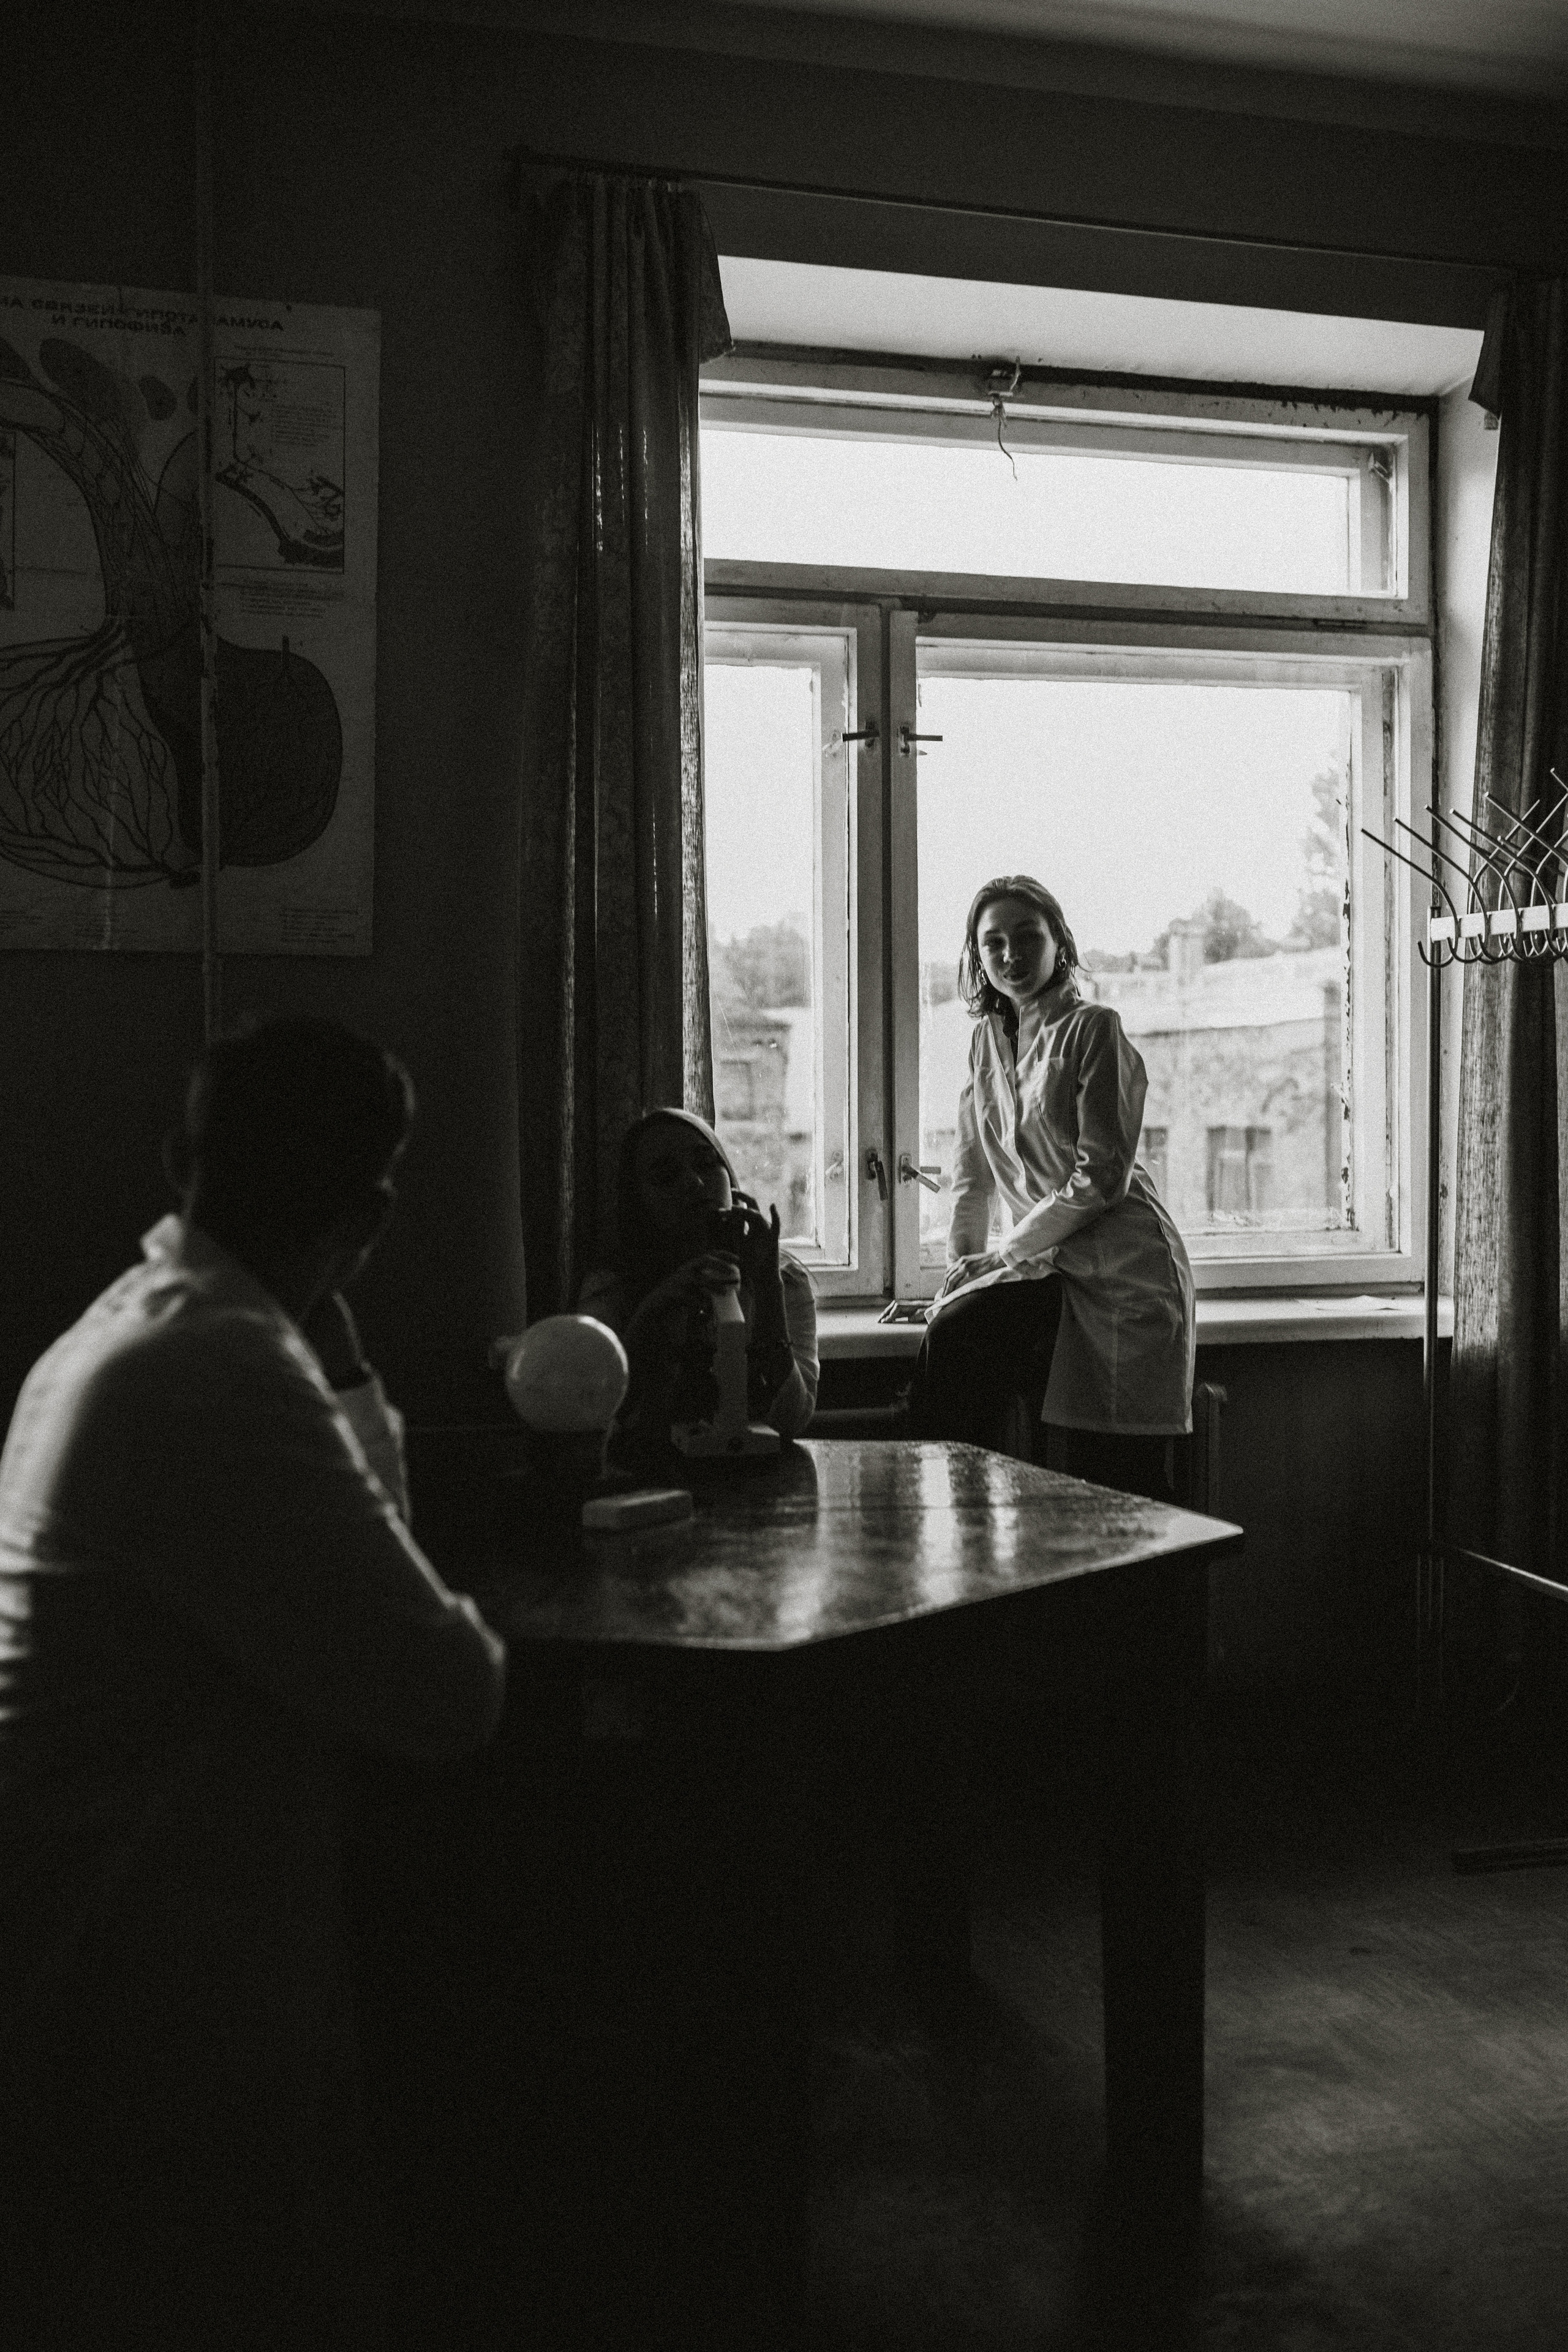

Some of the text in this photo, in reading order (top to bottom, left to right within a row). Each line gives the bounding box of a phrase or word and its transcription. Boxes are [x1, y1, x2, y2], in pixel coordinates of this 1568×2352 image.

[52, 314, 186, 336] И ГИПОФИЗА
[119, 306, 284, 331] ГИПОТААМУСА
